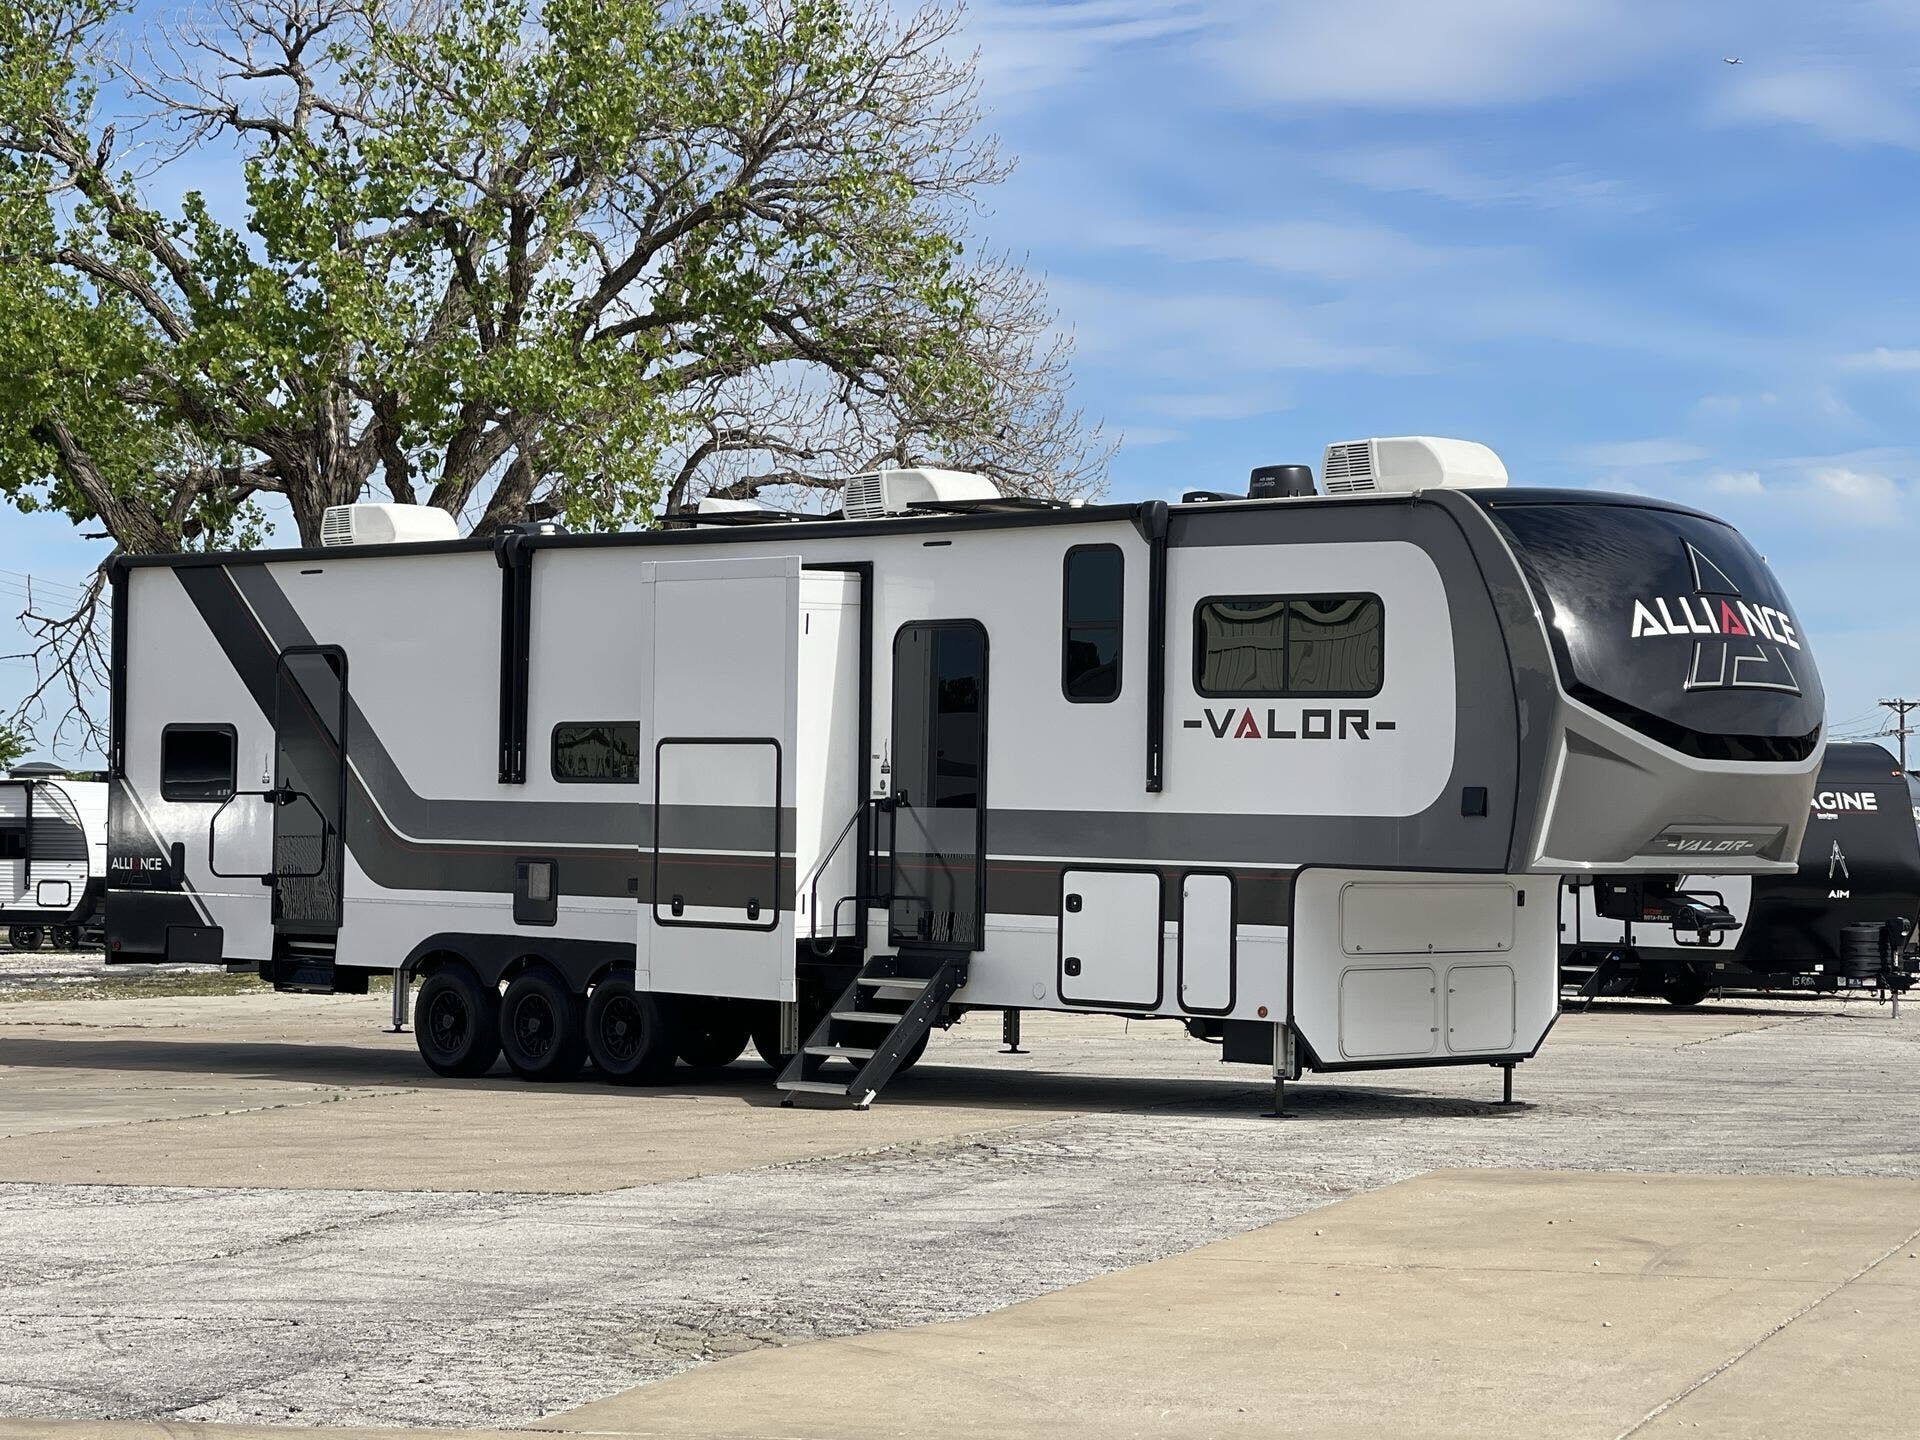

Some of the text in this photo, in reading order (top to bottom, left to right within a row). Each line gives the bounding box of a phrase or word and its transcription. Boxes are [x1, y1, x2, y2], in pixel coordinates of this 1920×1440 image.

[1632, 596, 1800, 651] ALLIANCE
[111, 857, 162, 871] ALLIANCE
[1828, 889, 1850, 898] AIM
